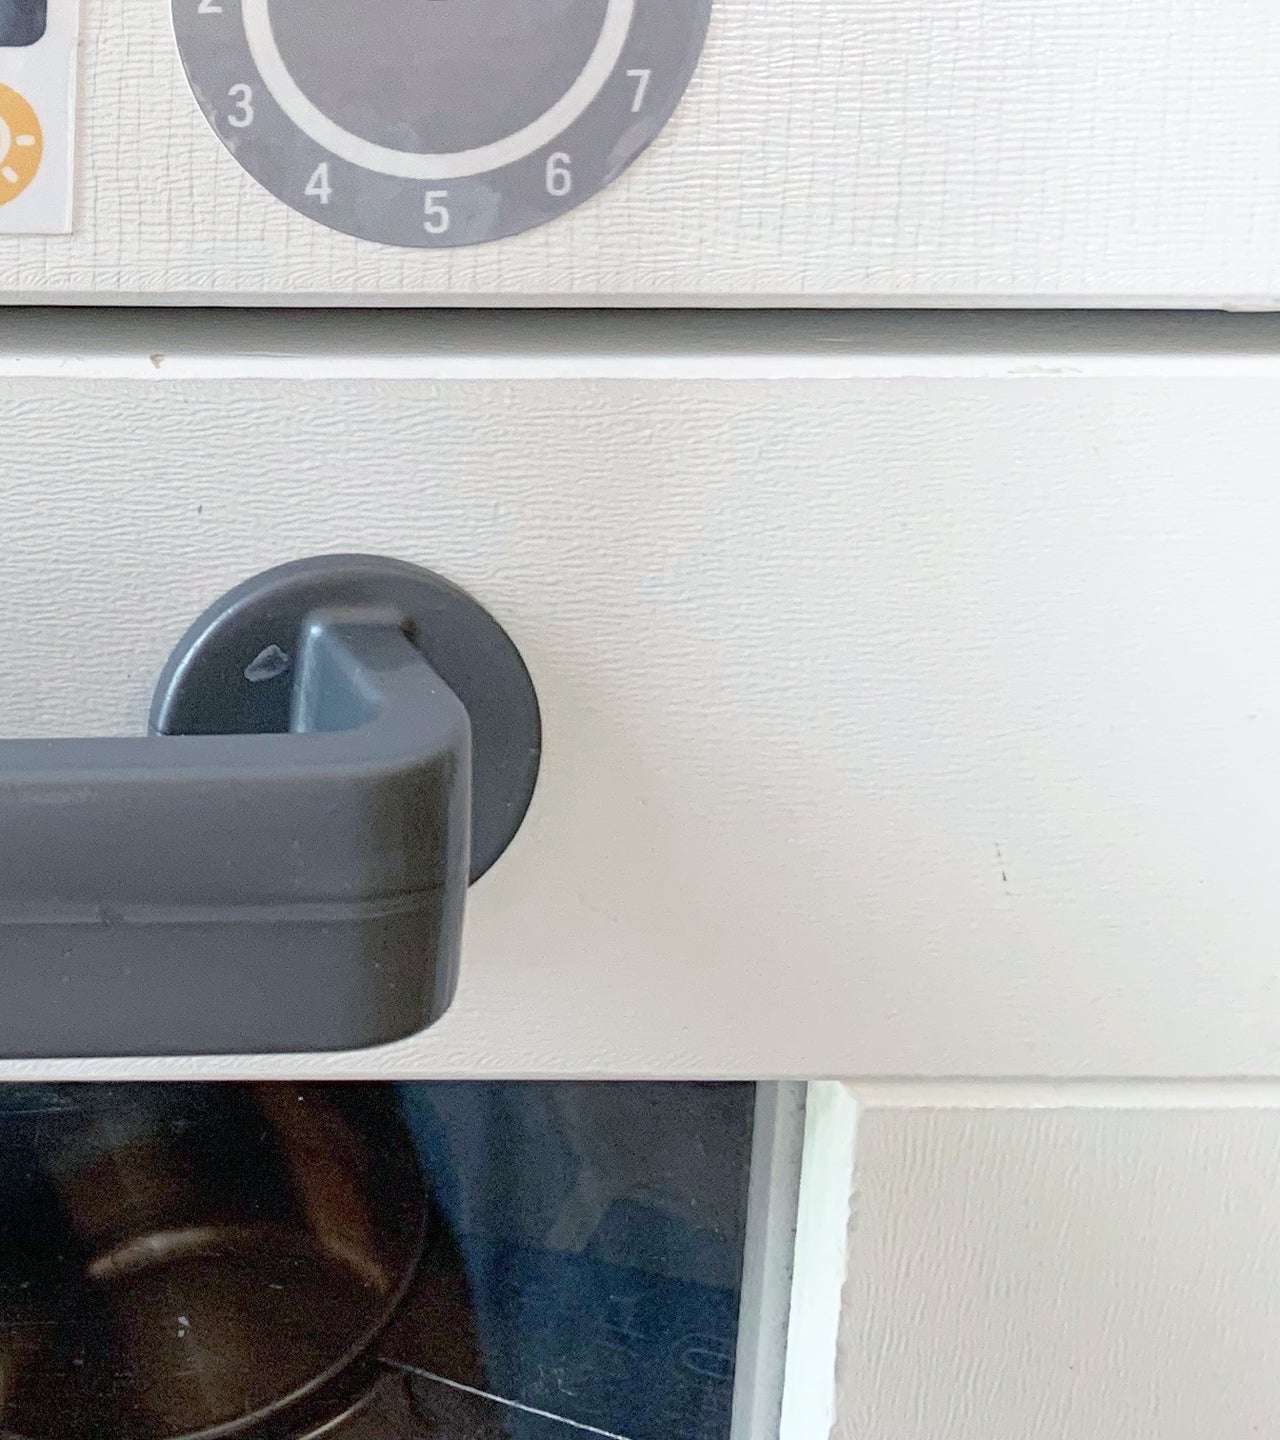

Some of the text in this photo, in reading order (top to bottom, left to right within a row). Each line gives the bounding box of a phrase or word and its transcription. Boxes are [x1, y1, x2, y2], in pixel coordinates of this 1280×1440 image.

[227, 84, 254, 127] 3
[626, 68, 652, 112] 7
[304, 161, 332, 204] 4
[545, 152, 572, 196] 6
[423, 190, 449, 234] 5
